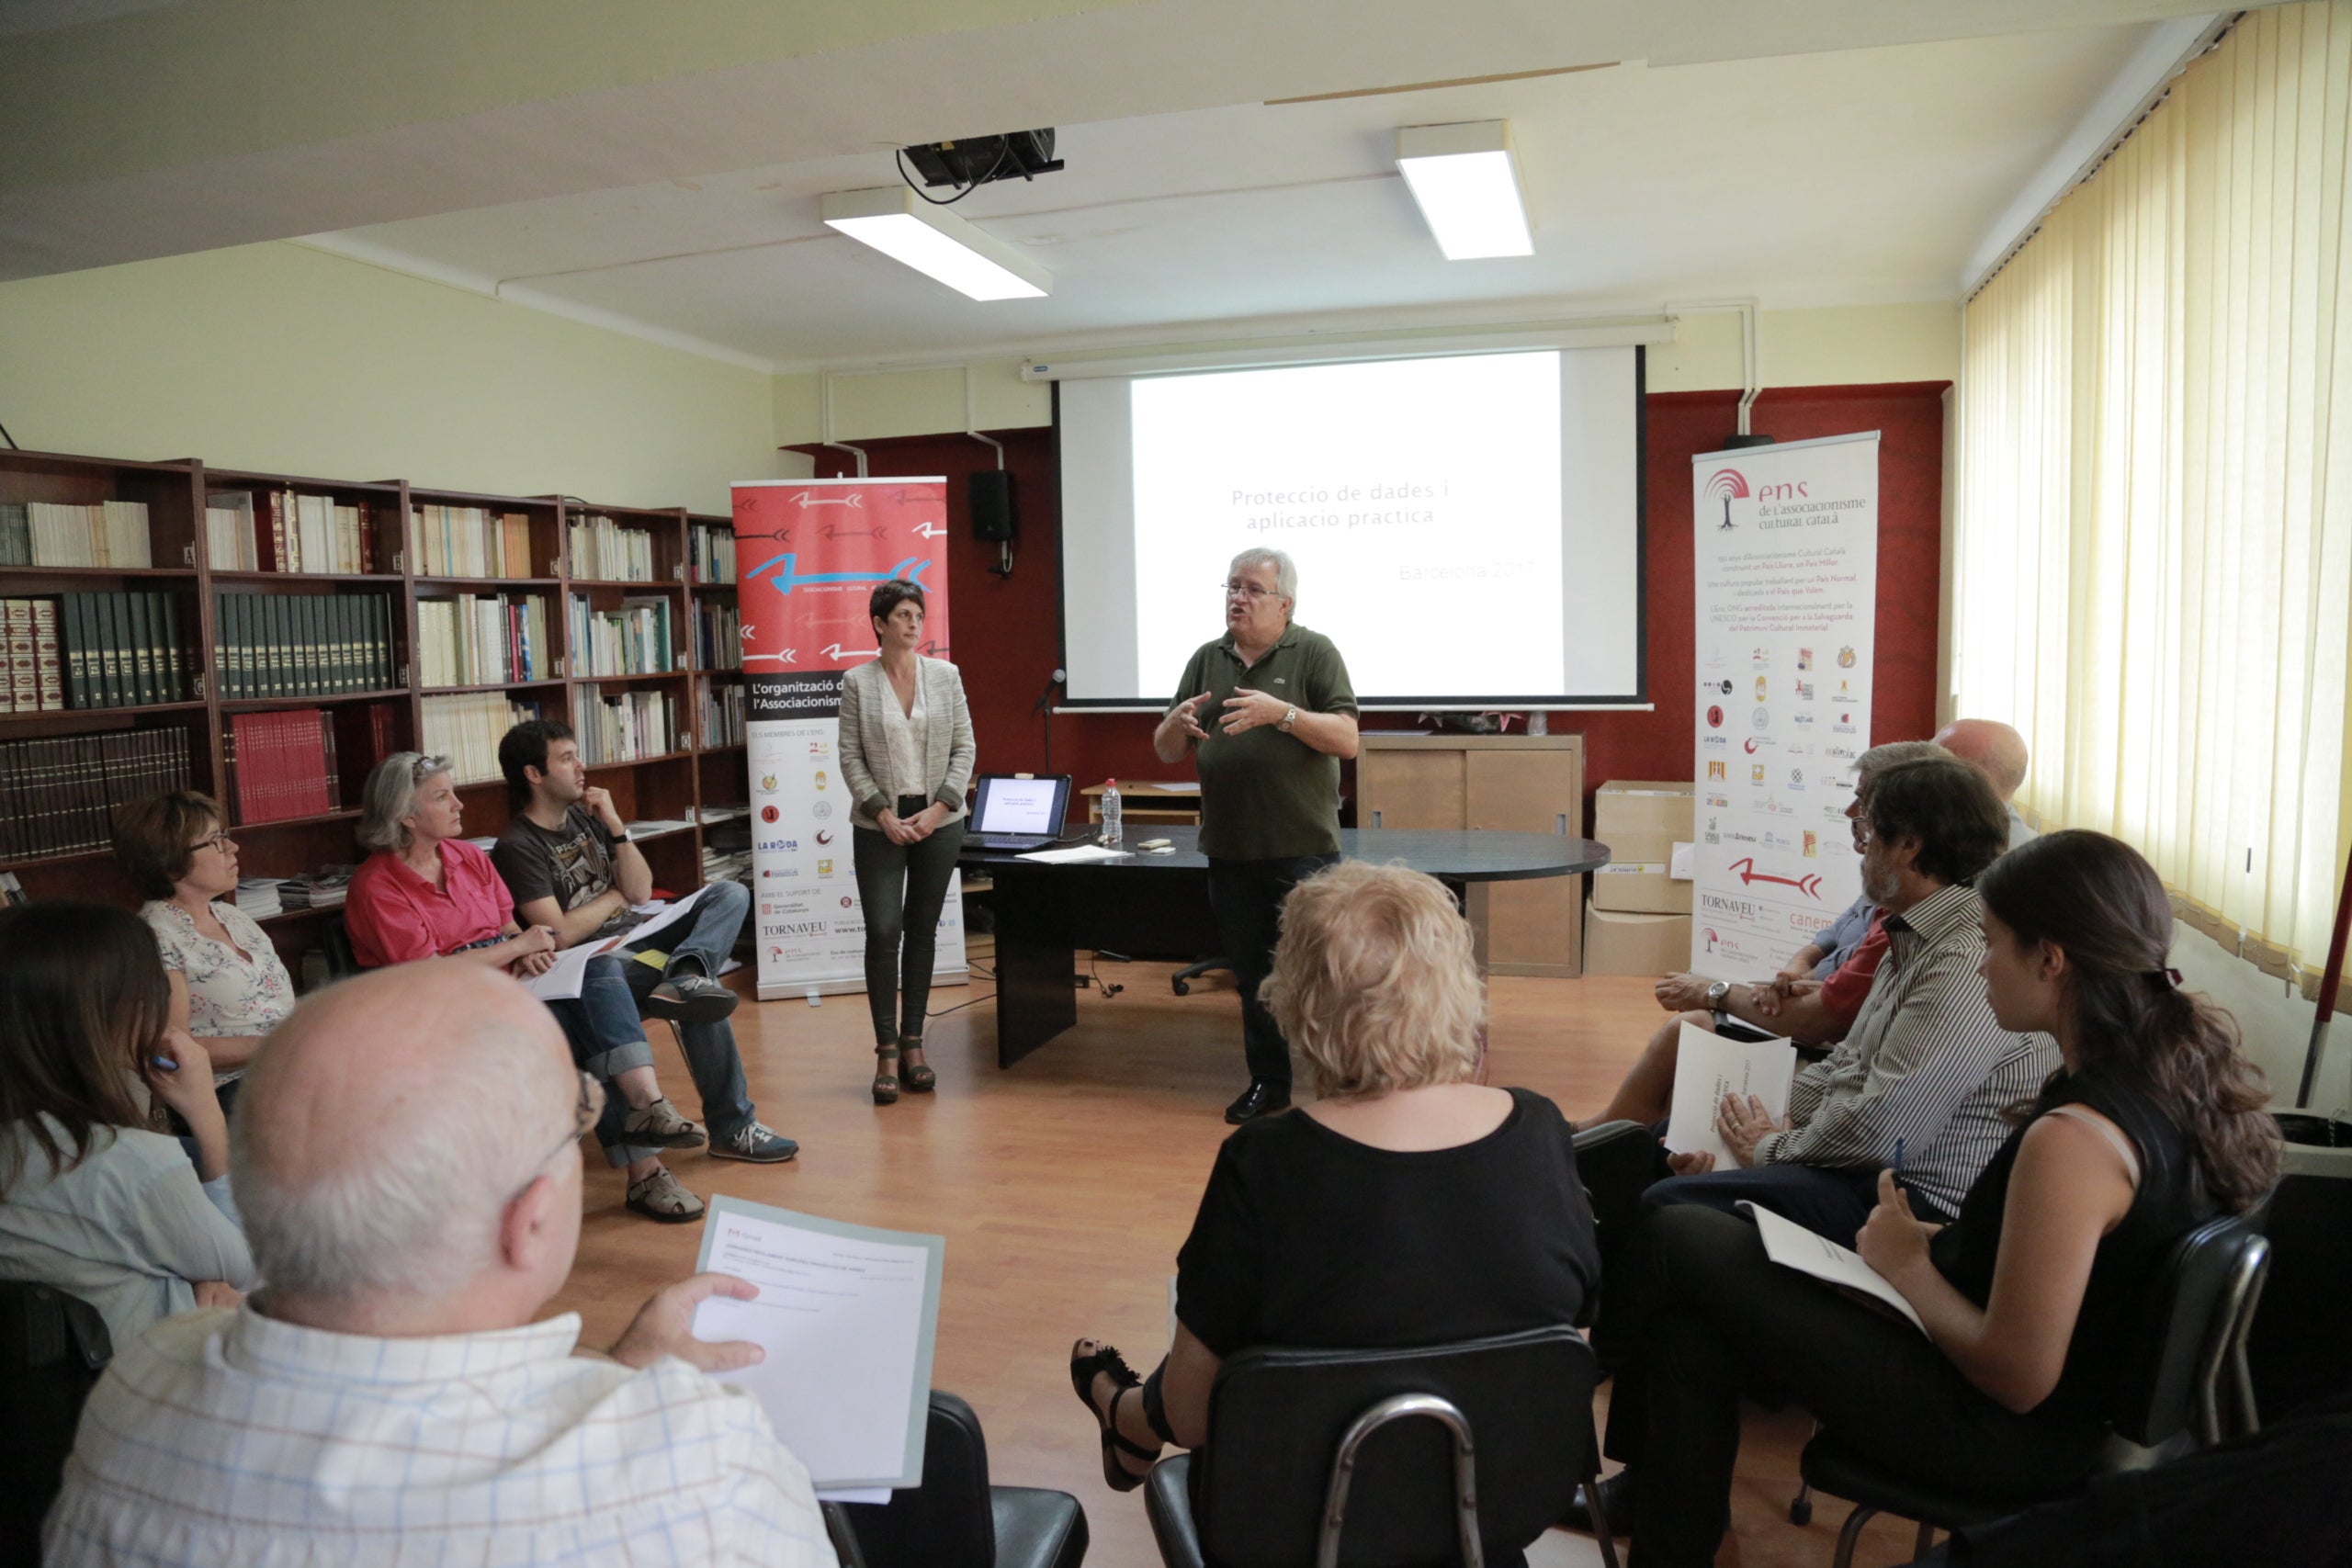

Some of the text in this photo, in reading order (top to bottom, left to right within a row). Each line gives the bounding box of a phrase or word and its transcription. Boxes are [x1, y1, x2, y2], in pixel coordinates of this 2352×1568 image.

[1337, 485, 1362, 502] de
[1370, 482, 1434, 500] dades
[1758, 480, 1808, 502] ens
[1759, 505, 1771, 517] de
[395, 556, 401, 568] B
[1399, 563, 1487, 581] Barcelona
[195, 680, 204, 694] G
[752, 679, 844, 696] L'organització d
[753, 696, 842, 709] l'Associacionism
[763, 729, 796, 739] MEMBRES
[758, 841, 768, 851] LA
[786, 888, 810, 897] SUPORT
[782, 908, 809, 916] Catalunya
[1702, 894, 1756, 916] TORNAVEU
[1790, 912, 1833, 930] canem
[762, 921, 827, 936] TORNAVEU
